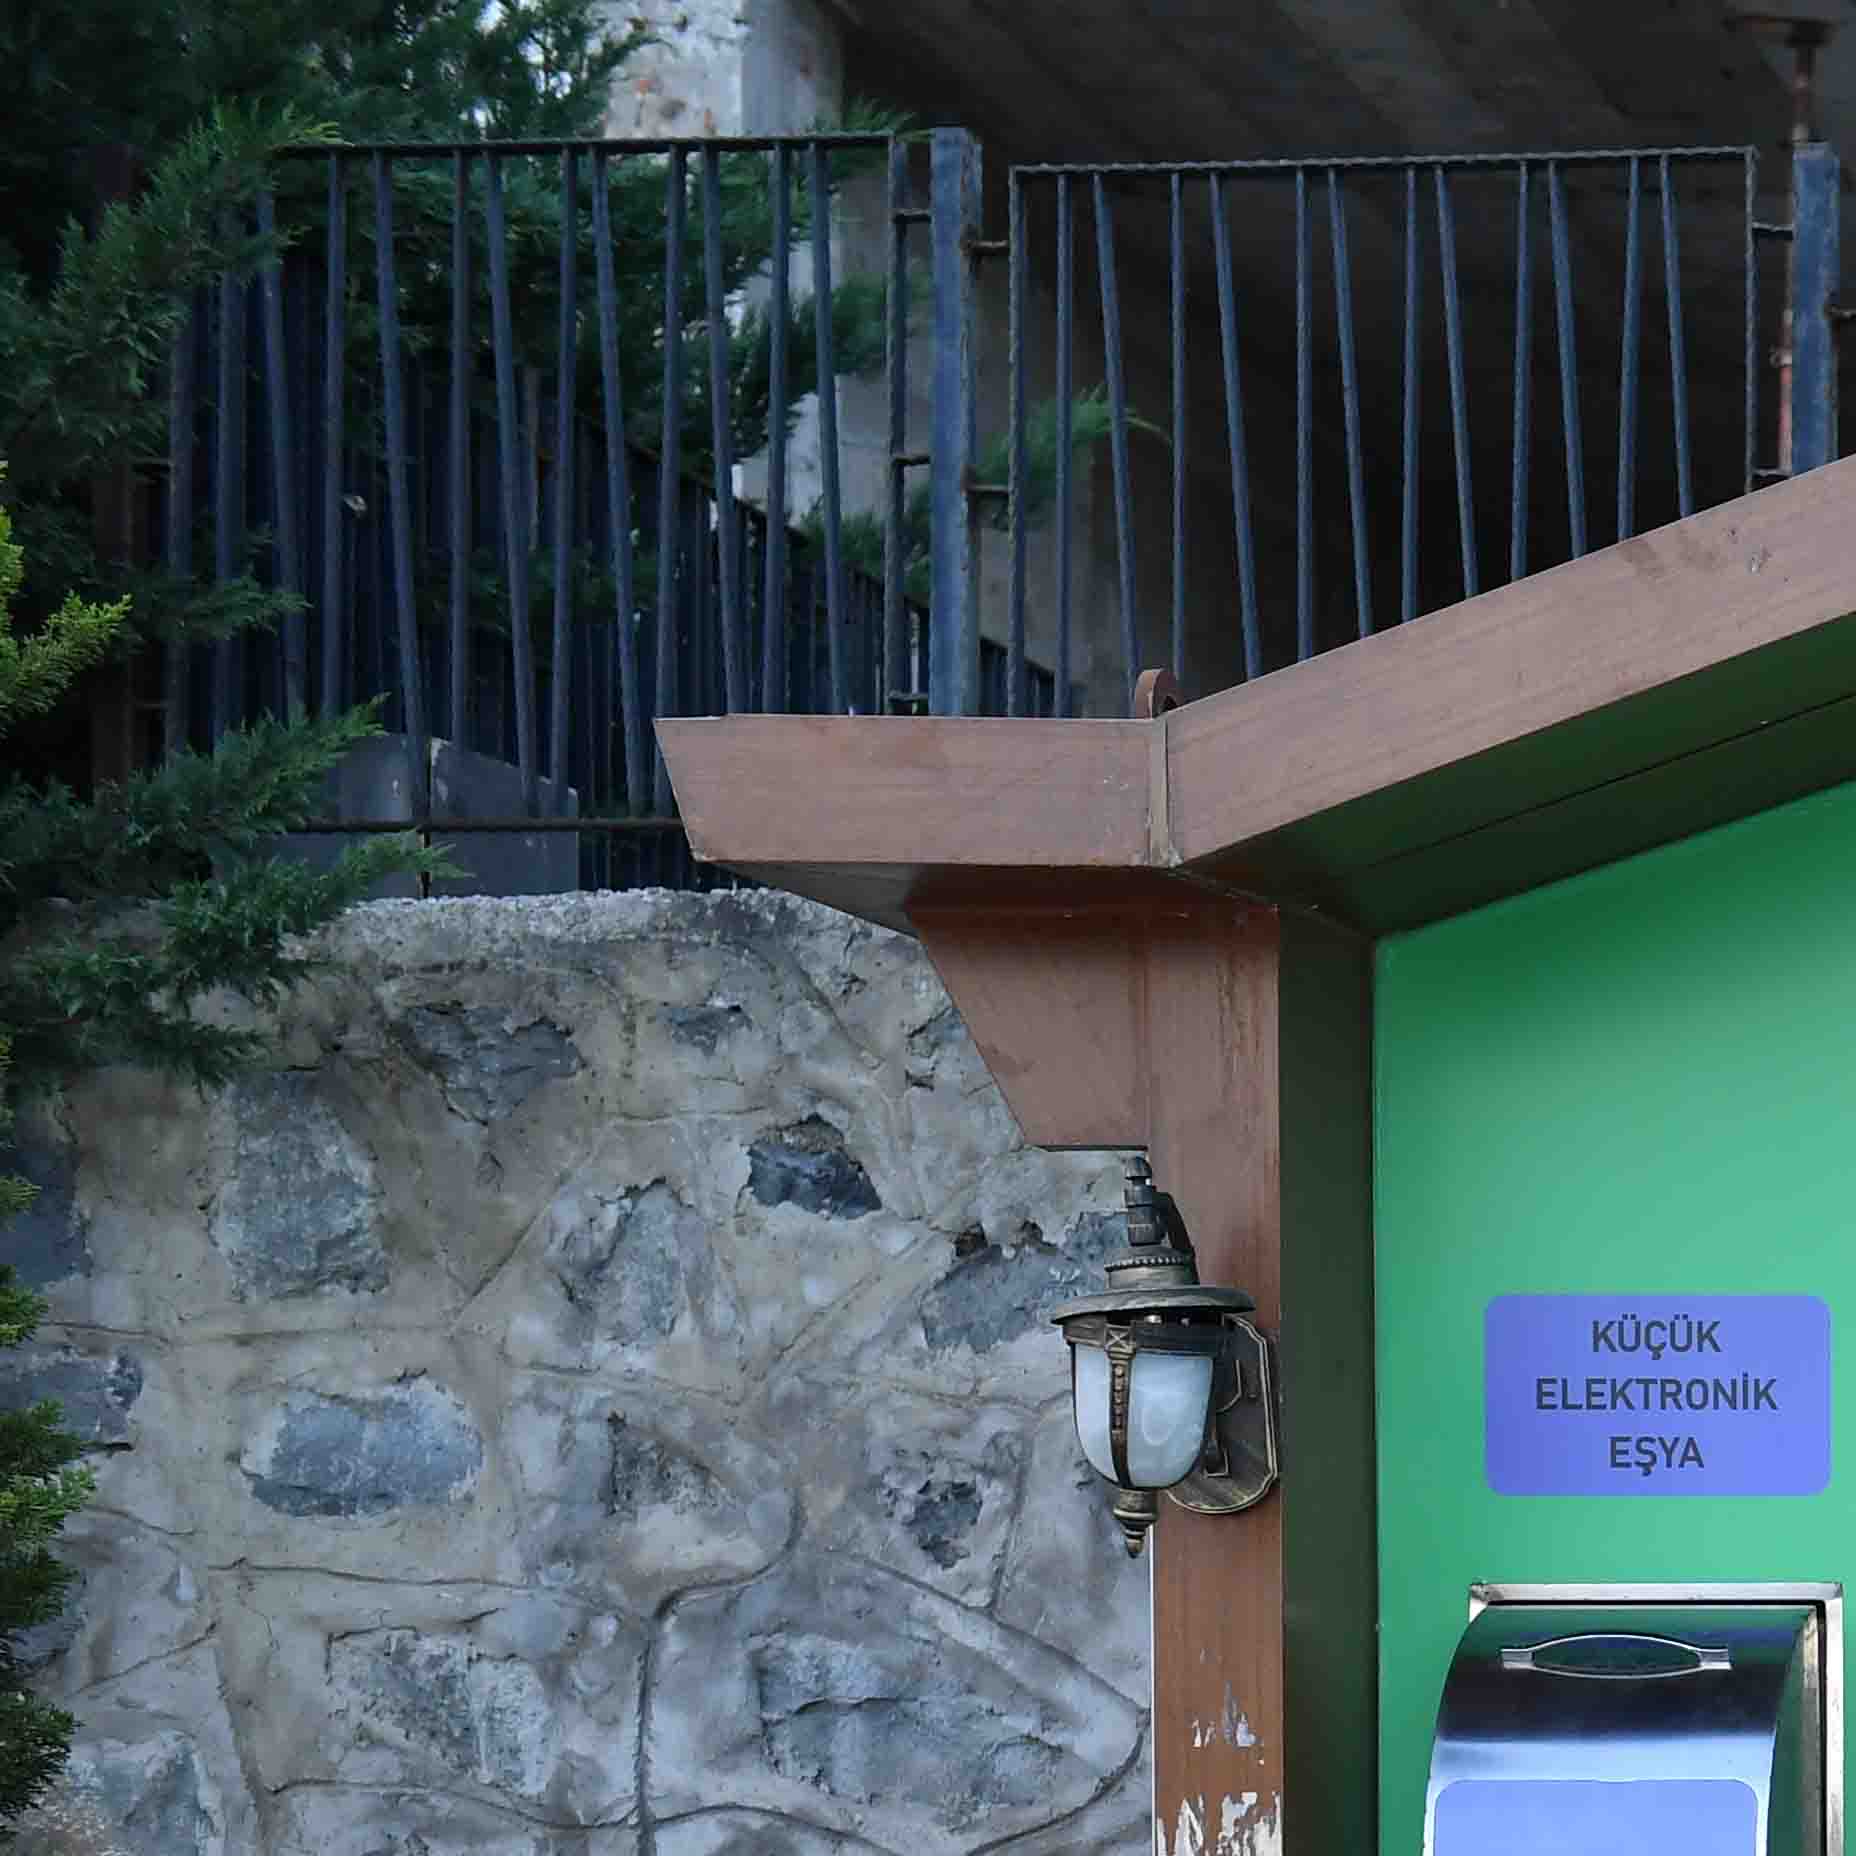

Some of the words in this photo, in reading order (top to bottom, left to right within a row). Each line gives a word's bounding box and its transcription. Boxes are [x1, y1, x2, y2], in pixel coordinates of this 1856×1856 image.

[1592, 1313, 1722, 1361] KÜÇÜK
[1535, 1371, 1779, 1411] ELEKTRONİK
[1609, 1436, 1705, 1477] EŞYA
